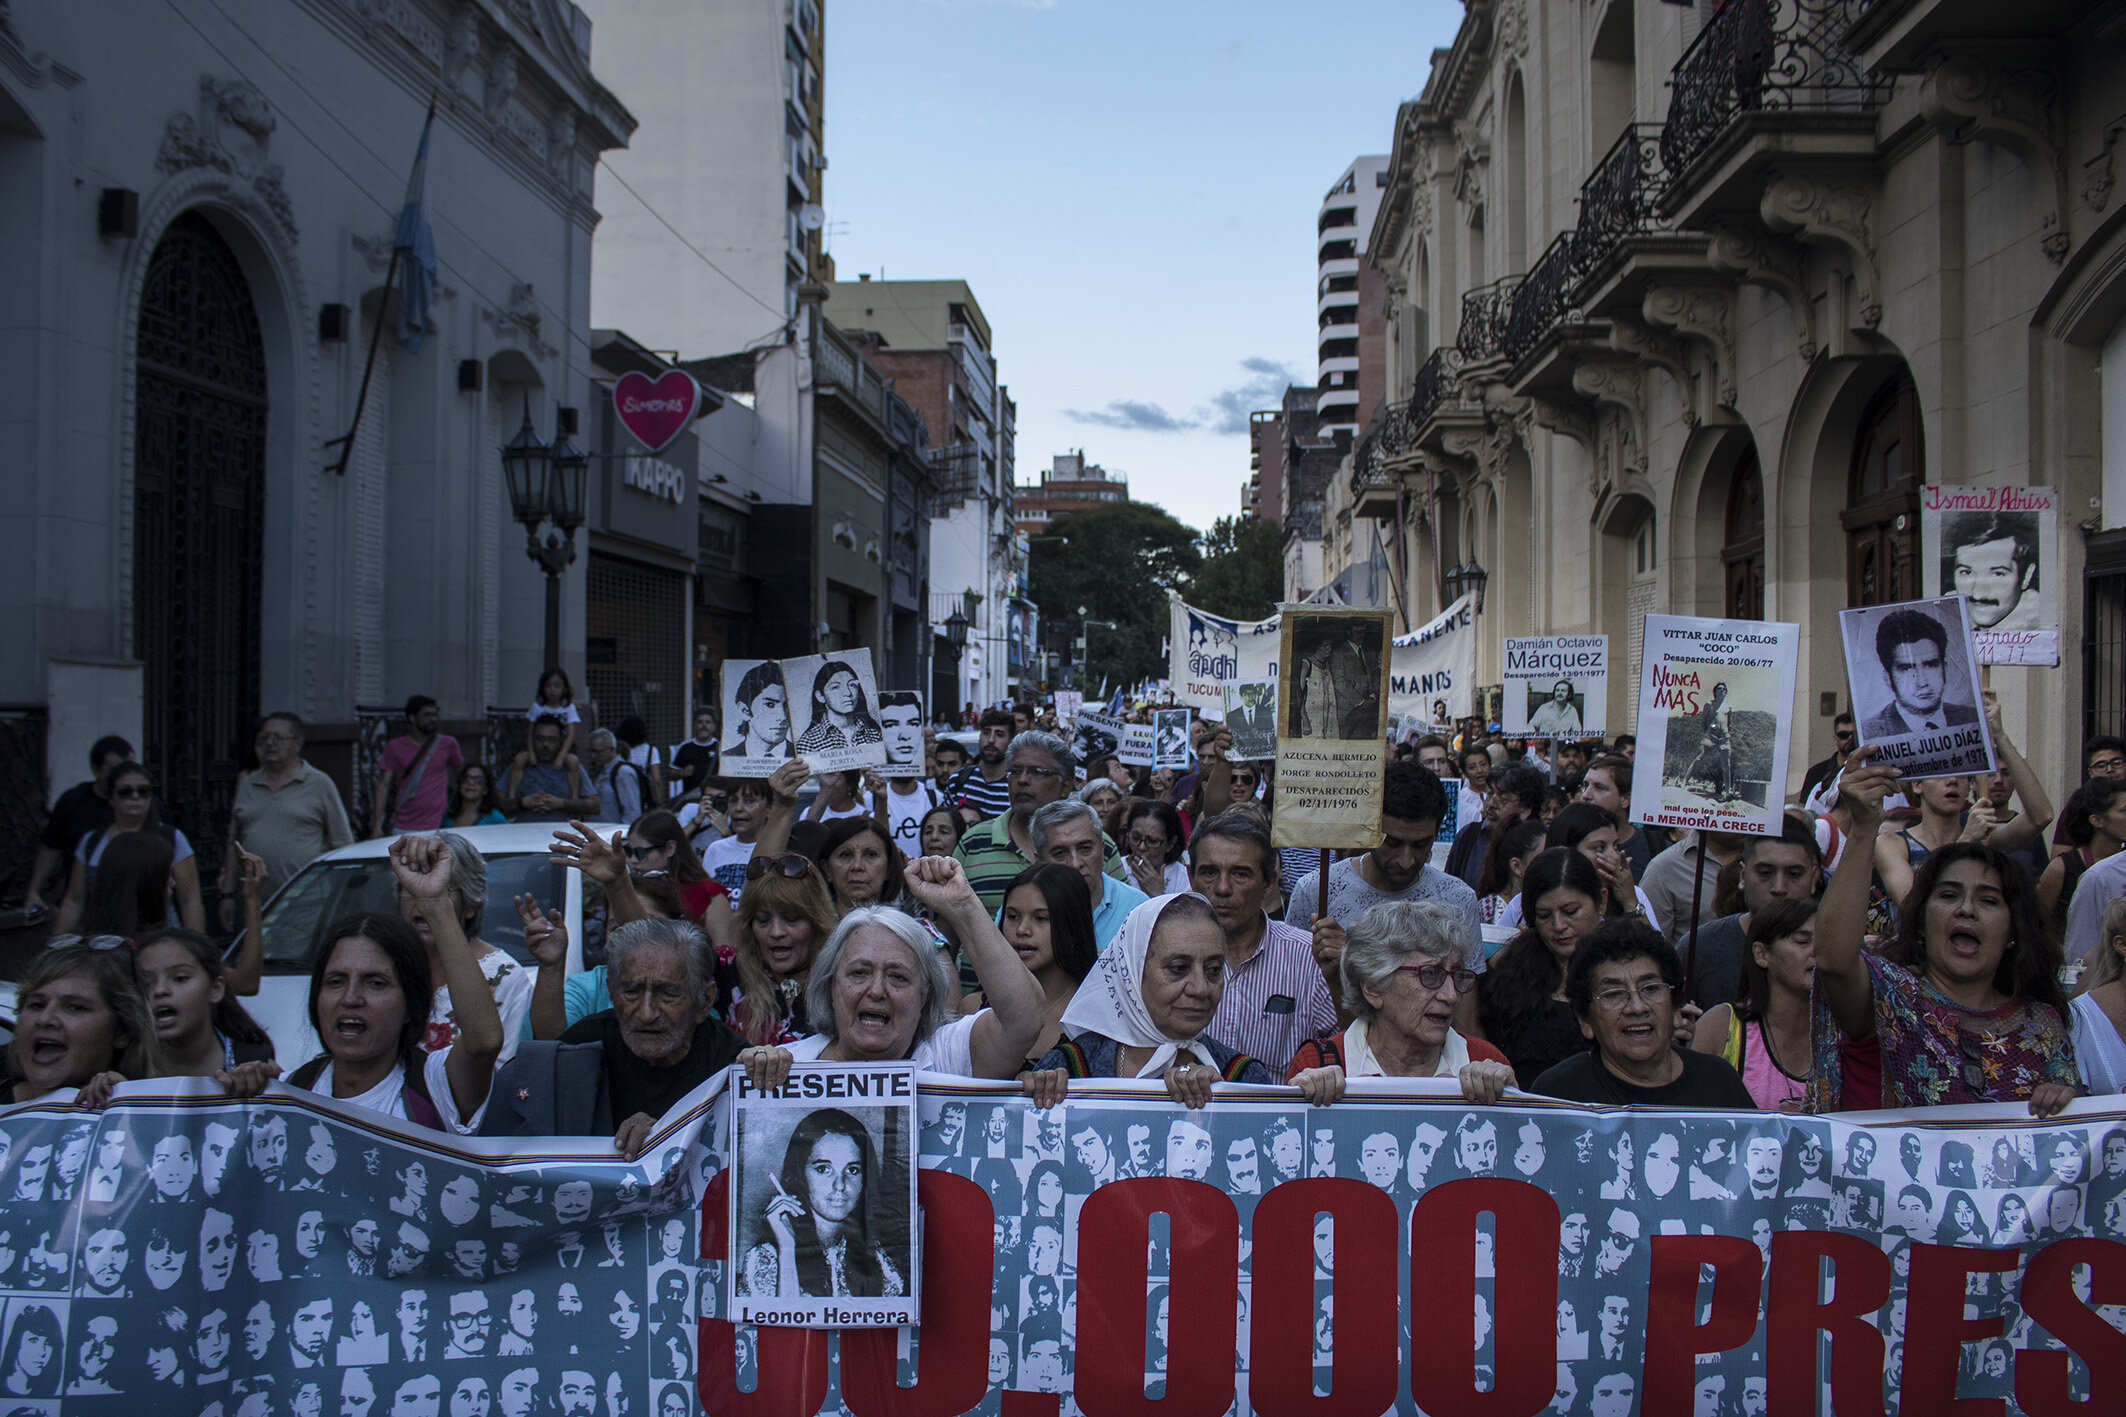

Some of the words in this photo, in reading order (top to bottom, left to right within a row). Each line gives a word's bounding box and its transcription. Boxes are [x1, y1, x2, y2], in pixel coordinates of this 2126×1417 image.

[1925, 486, 1997, 510] Ismael
[1507, 639, 1553, 650] Damián
[1556, 637, 1603, 649] Octavio
[1663, 629, 1702, 640] VITTAR
[1704, 632, 1733, 642] JUAN
[1735, 634, 1778, 645] CARLOS
[1189, 650, 1238, 680] apdh
[1508, 650, 1602, 671] Márquez
[1663, 653, 1725, 665] Desaparecido
[1727, 657, 1774, 668] 20/06/77
[1391, 669, 1452, 694] MANOS
[1504, 672, 1560, 680] Desaparecido
[1562, 670, 1606, 678] 13/01/1977
[1652, 663, 1701, 690] NUNCA
[1653, 687, 1699, 716] MAS
[1078, 711, 1124, 730] PRESENTE
[1502, 730, 1550, 738] Recuperado
[1918, 735, 1953, 755] JULIO
[1954, 728, 1982, 748] DÍAZ
[1125, 739, 1153, 749] FUERA
[829, 757, 856, 767] ZURITA
[1283, 752, 1328, 761] AZUCENA
[1332, 754, 1377, 762] BERMEJO
[1951, 753, 1964, 767] de
[1286, 786, 1370, 796] DESAPARECIDOS
[1299, 798, 1358, 809] 02/11/1976
[1682, 807, 1699, 815] que
[1701, 807, 1714, 815] les
[1643, 813, 1654, 822] la
[1658, 815, 1718, 829] MEMORIA
[1722, 821, 1766, 833] CRECE
[742, 1307, 816, 1325] Leonor
[823, 1307, 909, 1324] Herrera
